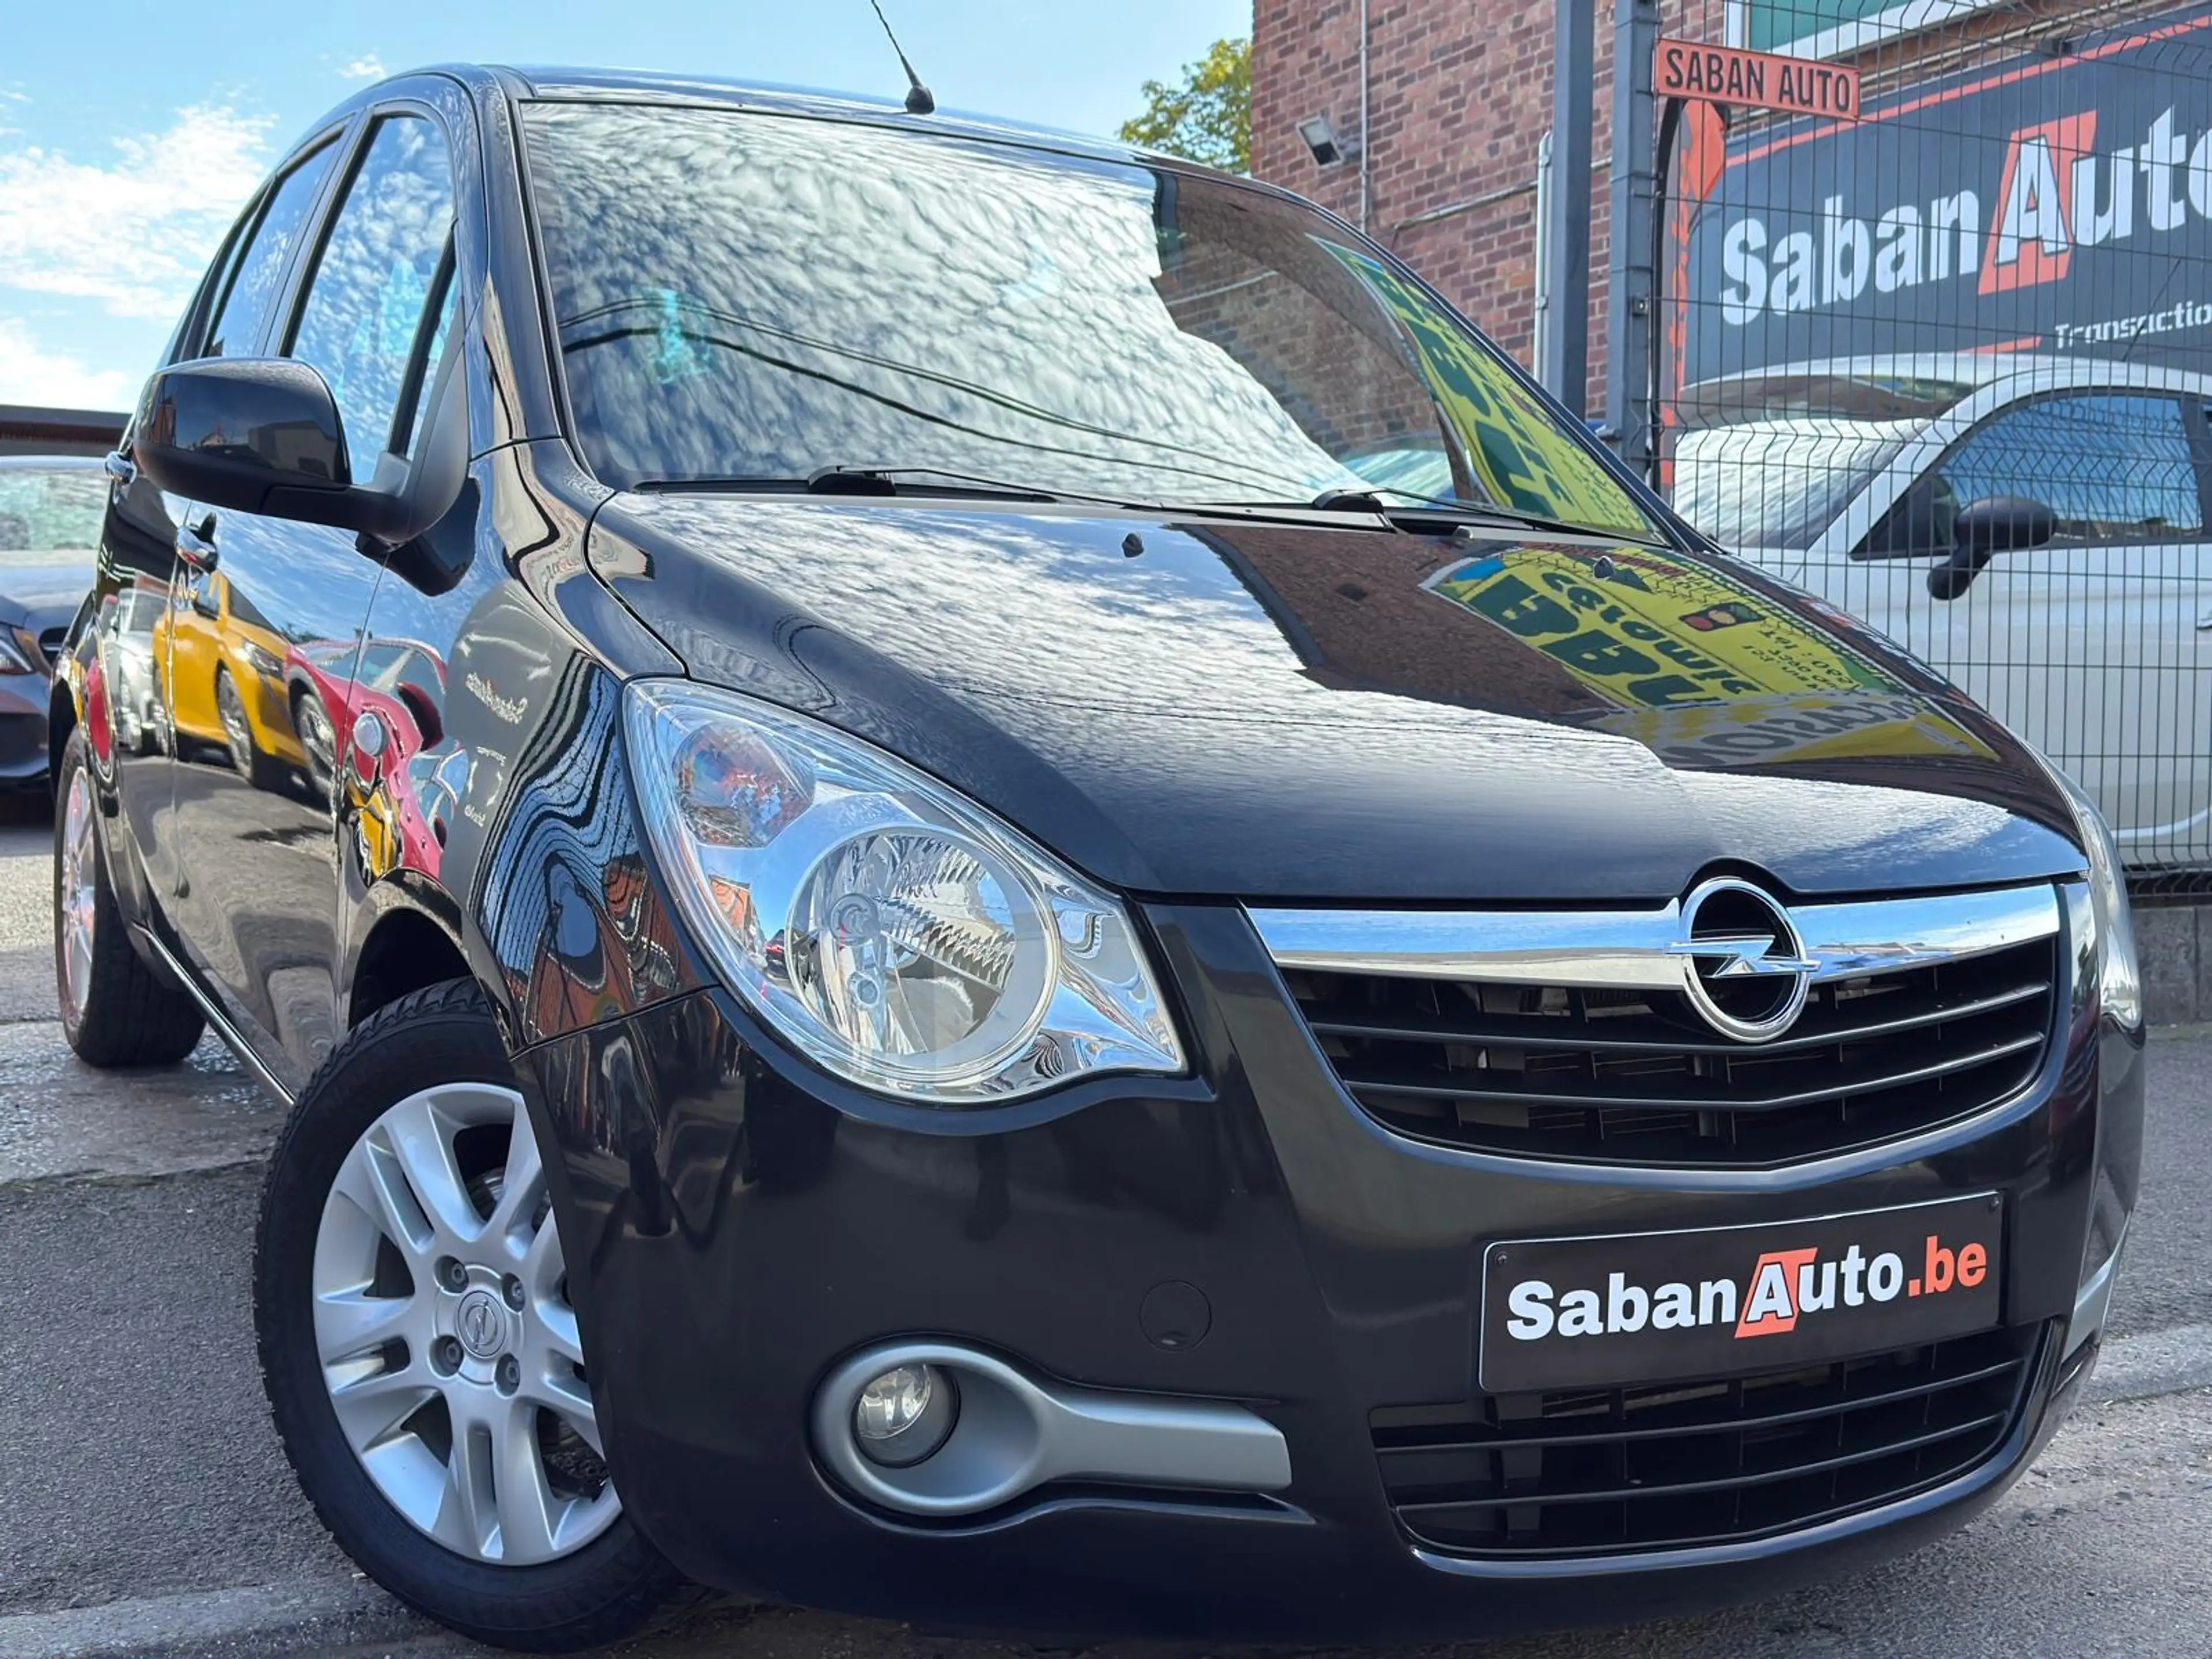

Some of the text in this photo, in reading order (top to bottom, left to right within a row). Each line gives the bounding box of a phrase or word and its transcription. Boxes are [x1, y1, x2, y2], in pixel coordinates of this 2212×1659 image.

[1665, 48, 1850, 112] SABAN AUTO
[1506, 1235, 1987, 1341] SabanAuto.be
